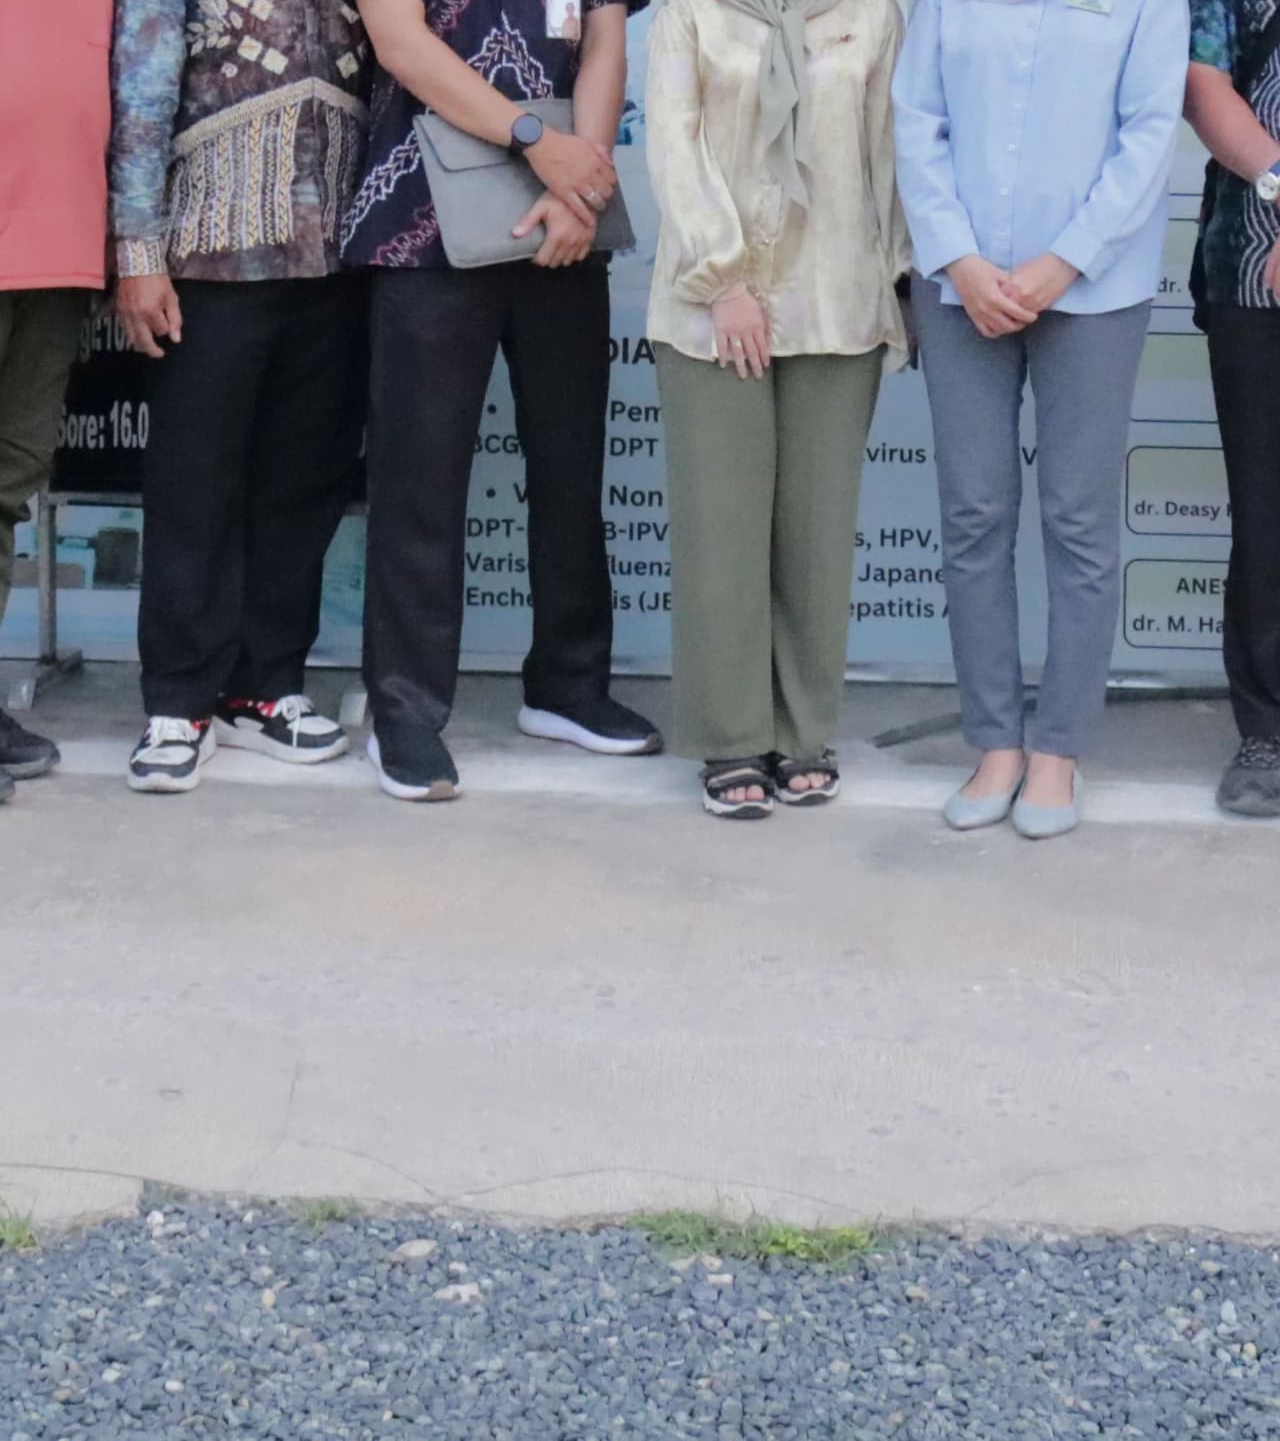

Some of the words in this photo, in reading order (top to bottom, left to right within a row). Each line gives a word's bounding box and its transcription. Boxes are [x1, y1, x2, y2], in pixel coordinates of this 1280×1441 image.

[609, 437, 660, 457] DPT
[609, 485, 664, 507] Non
[1134, 500, 1160, 515] dr.
[1165, 501, 1221, 521] Deasy
[879, 528, 939, 553] HPV,
[1132, 614, 1160, 632] dr.
[1168, 615, 1193, 633] M.
